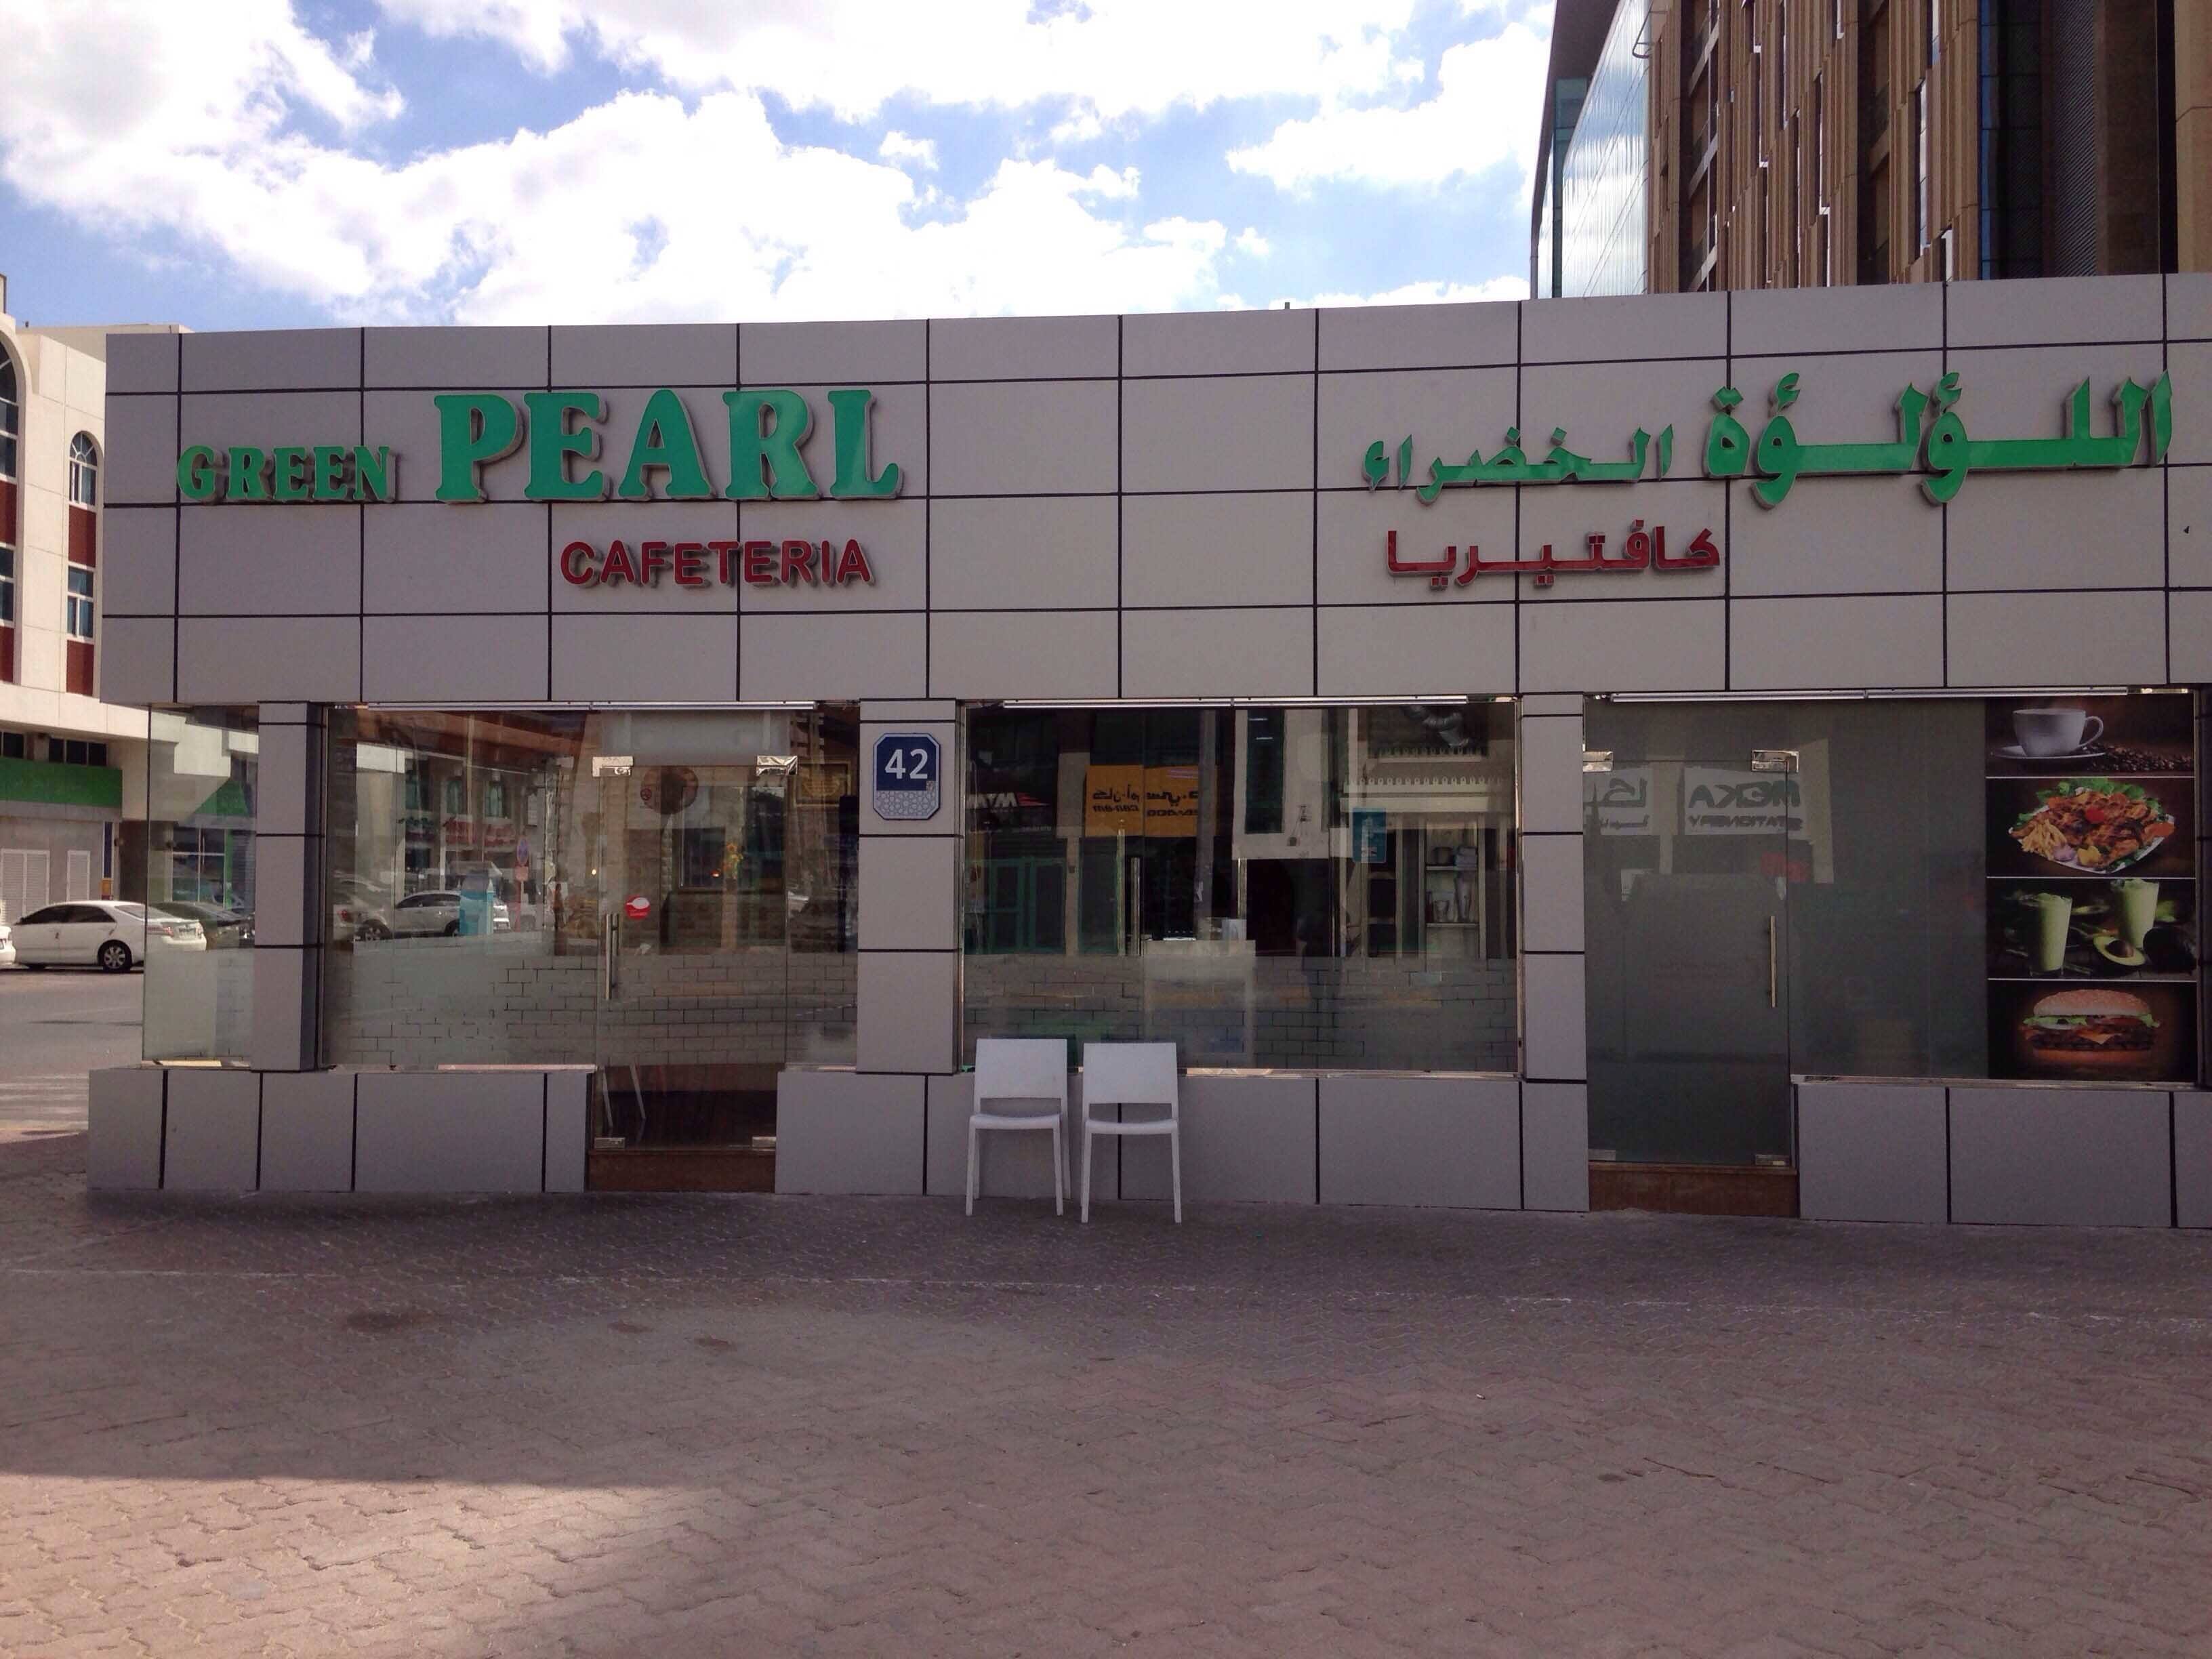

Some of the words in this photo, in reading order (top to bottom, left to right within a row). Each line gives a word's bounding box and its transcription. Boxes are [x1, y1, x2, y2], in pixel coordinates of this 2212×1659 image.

[177, 444, 398, 503] GREEN
[432, 386, 905, 501] PEARL
[1362, 424, 1674, 504] الخضراء
[1703, 371, 2173, 508] اللؤلؤة
[559, 538, 874, 587] CAFETERIA
[1387, 518, 1721, 588] كافتيريا
[884, 748, 928, 780] 42
